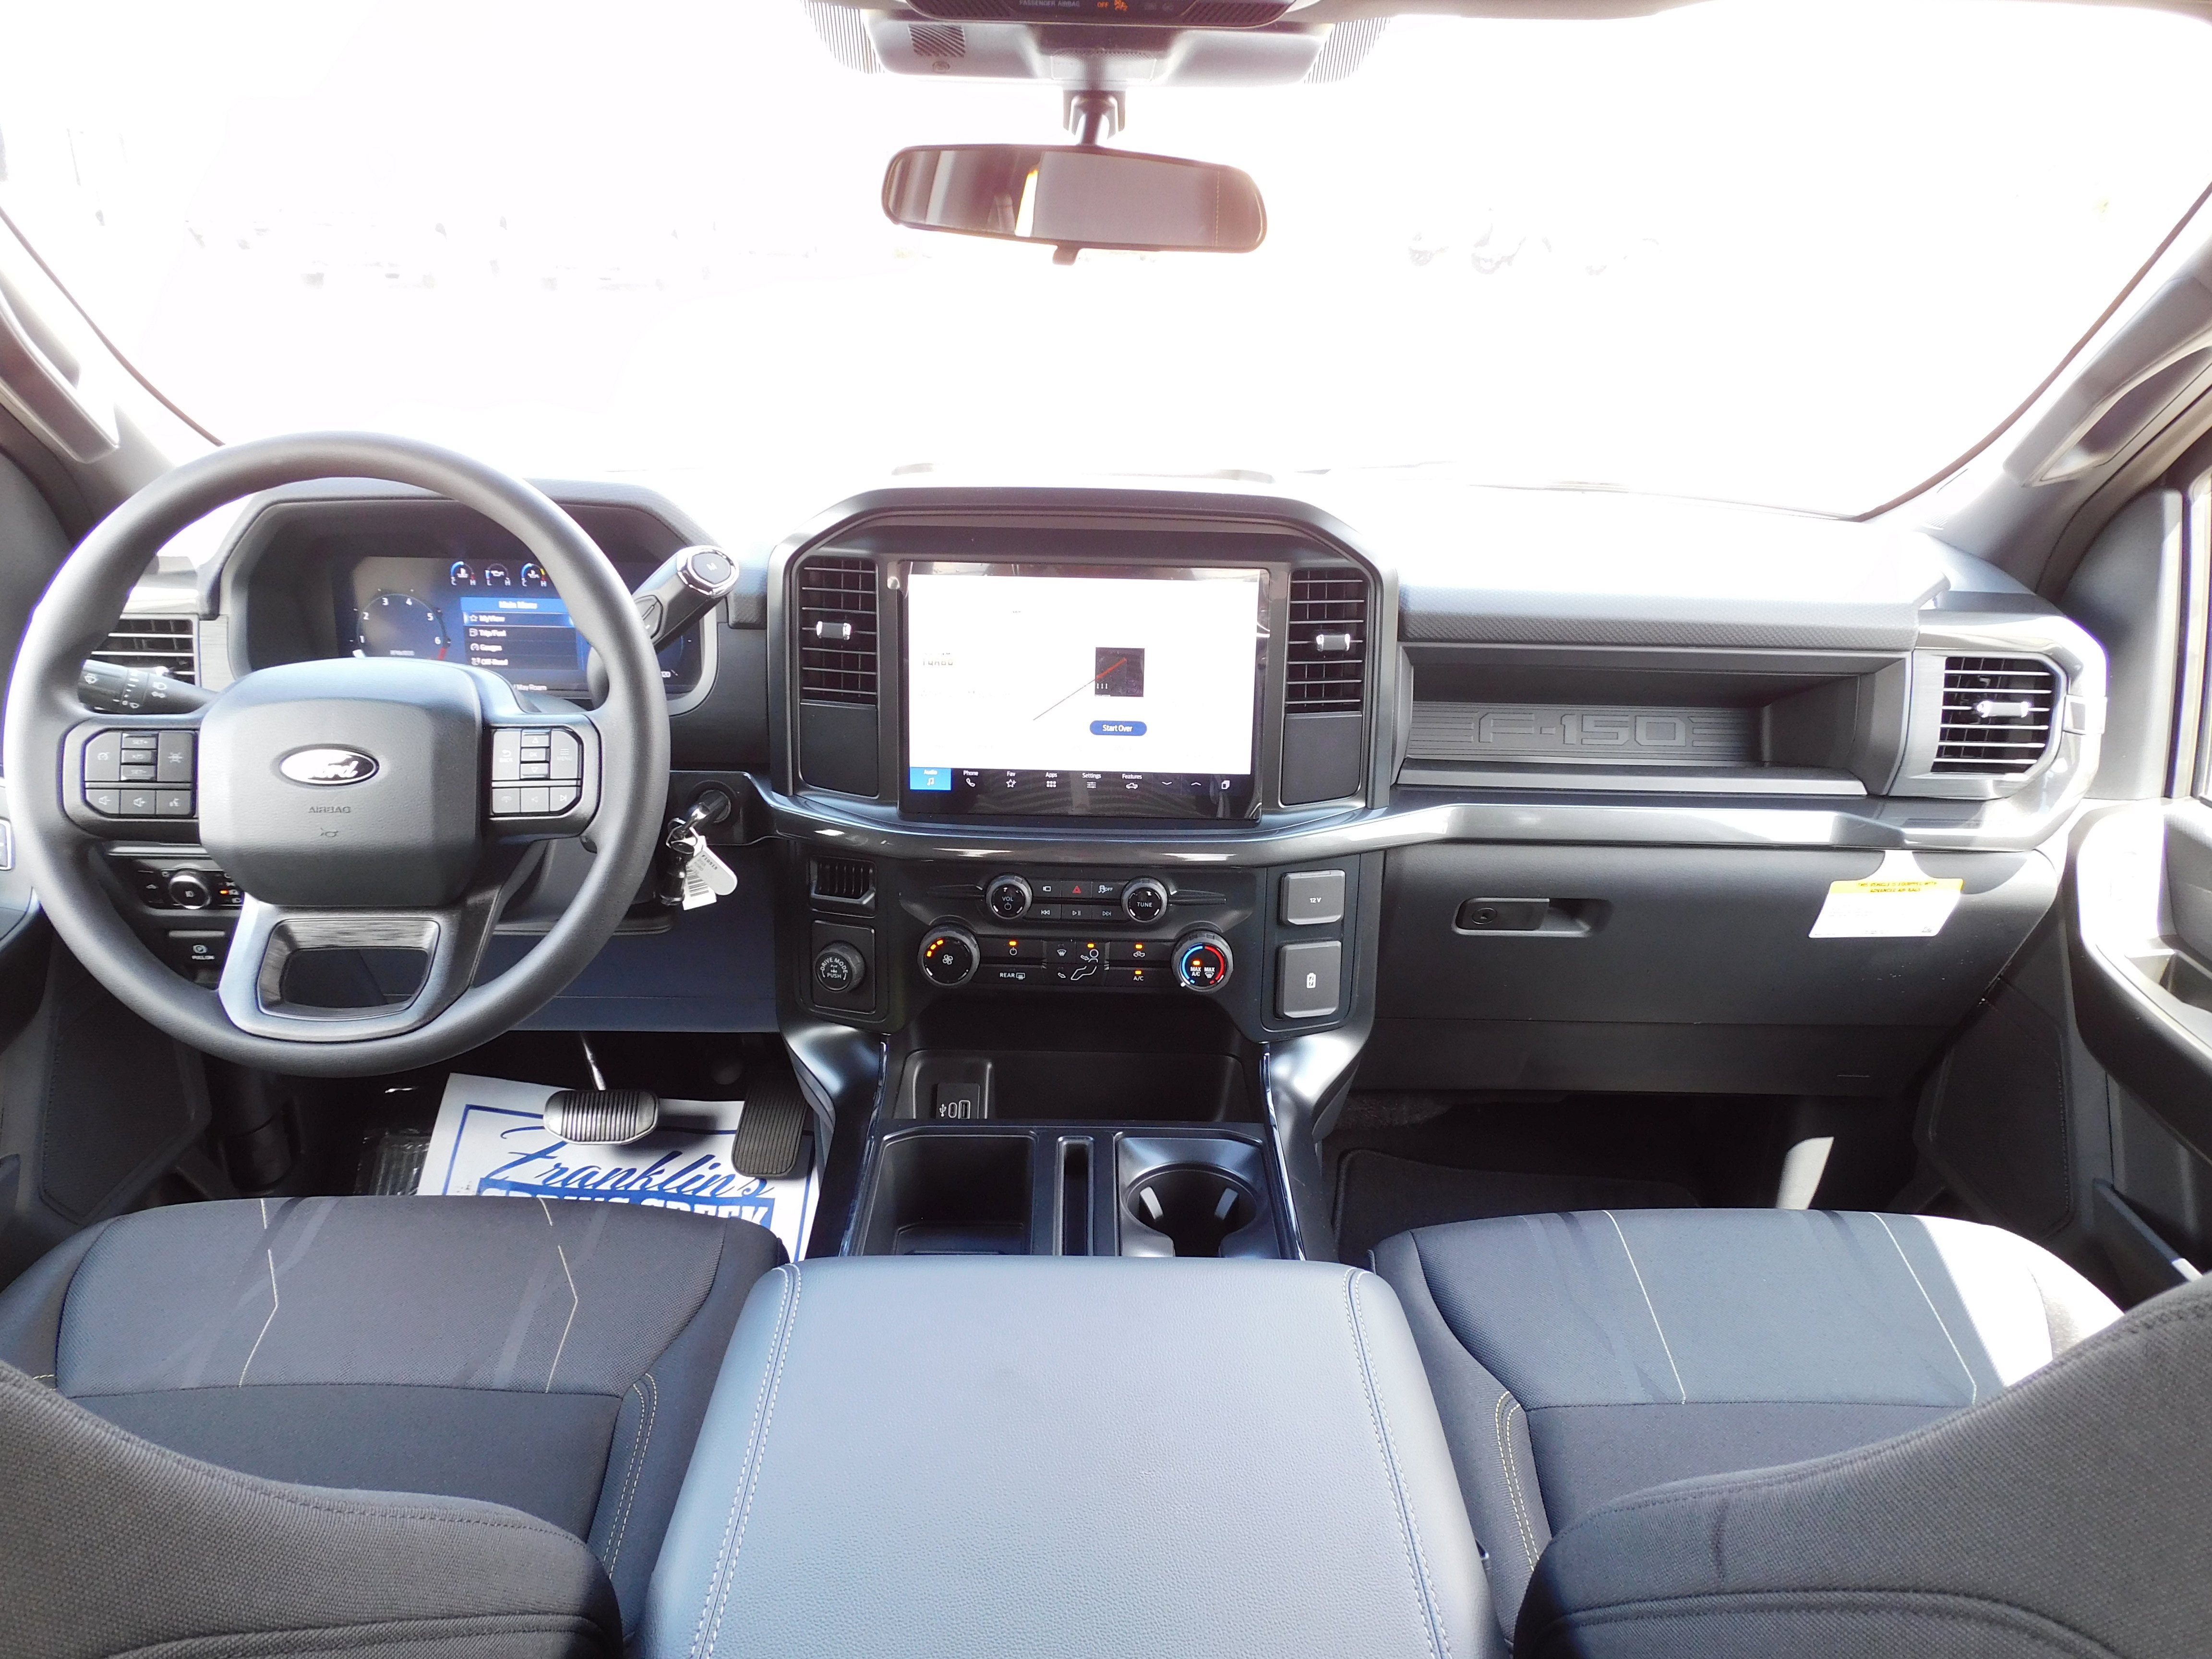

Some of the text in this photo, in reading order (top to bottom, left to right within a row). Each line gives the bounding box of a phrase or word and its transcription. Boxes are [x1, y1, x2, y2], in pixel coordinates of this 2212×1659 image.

[1479, 712, 1686, 746] F-150
[820, 957, 848, 973] DRIVE MODE
[489, 1126, 775, 1196] Franklins
